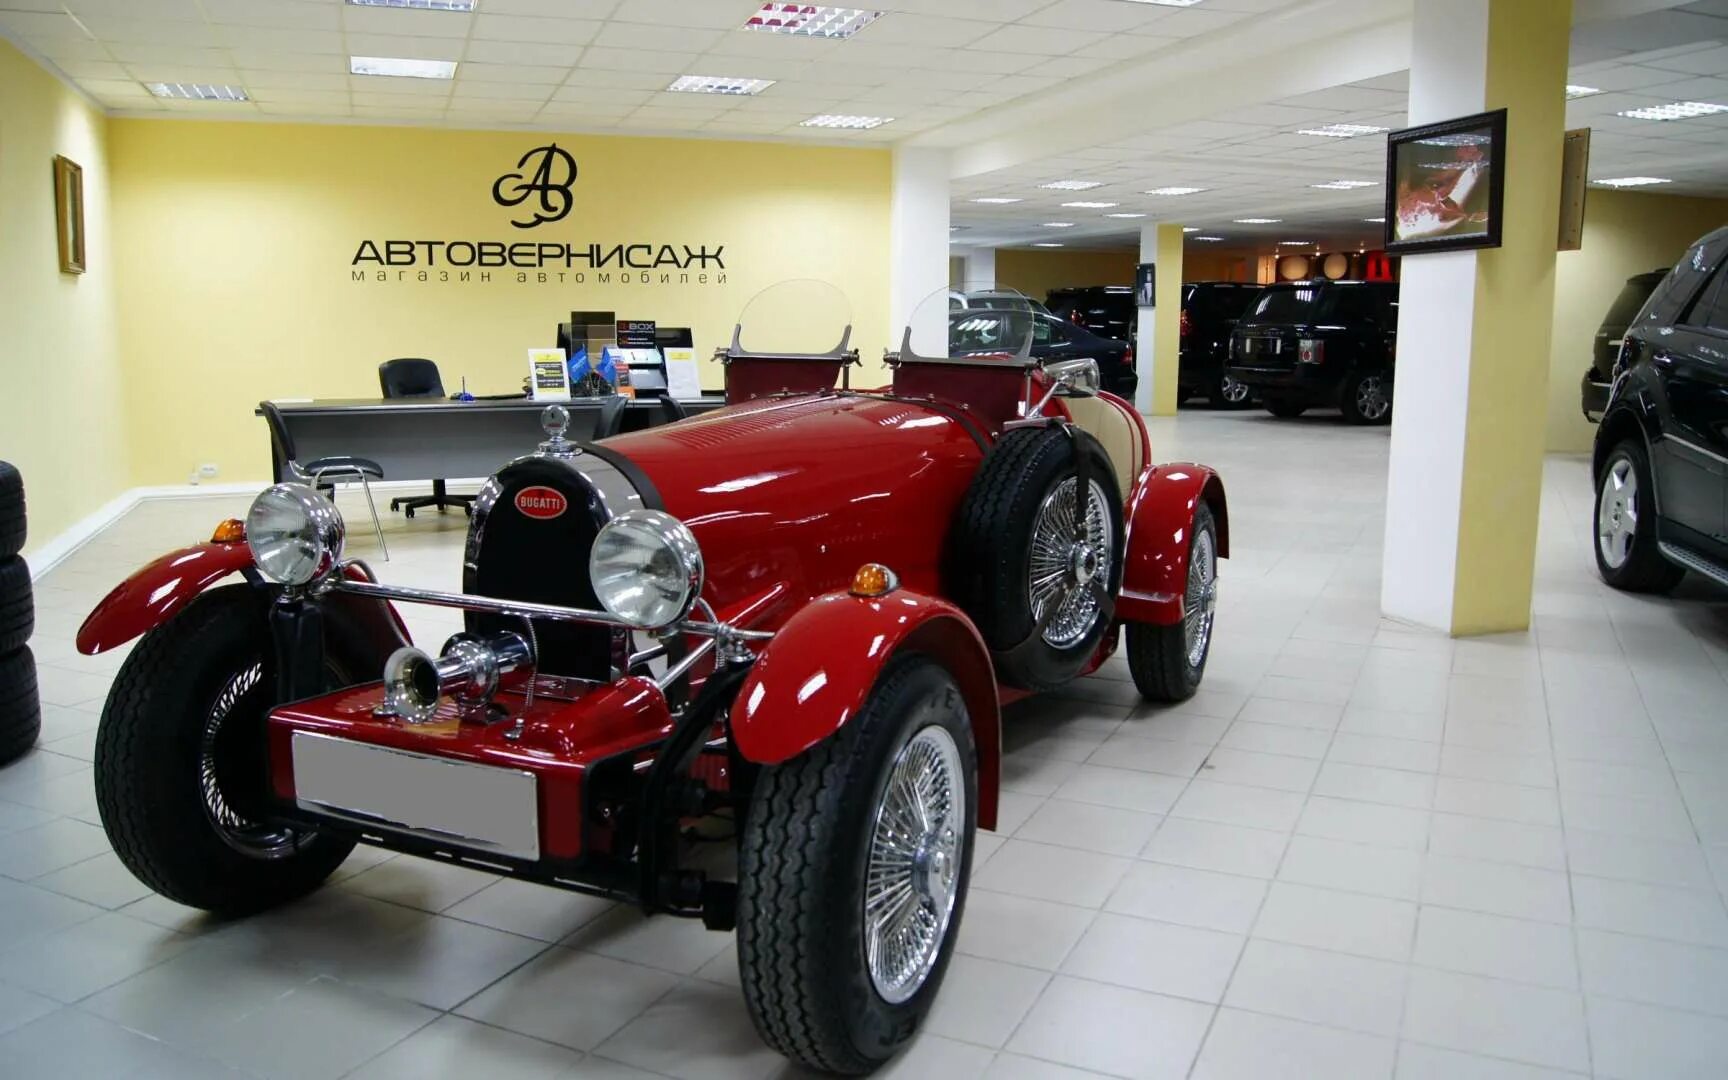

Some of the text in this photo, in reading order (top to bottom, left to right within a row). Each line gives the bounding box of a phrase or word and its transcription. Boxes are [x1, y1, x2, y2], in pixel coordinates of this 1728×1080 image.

[352, 240, 725, 269] АВТОВЕРНИСАЖ
[351, 269, 727, 284] магазин автомобилей
[520, 496, 560, 509] BUGATTI
